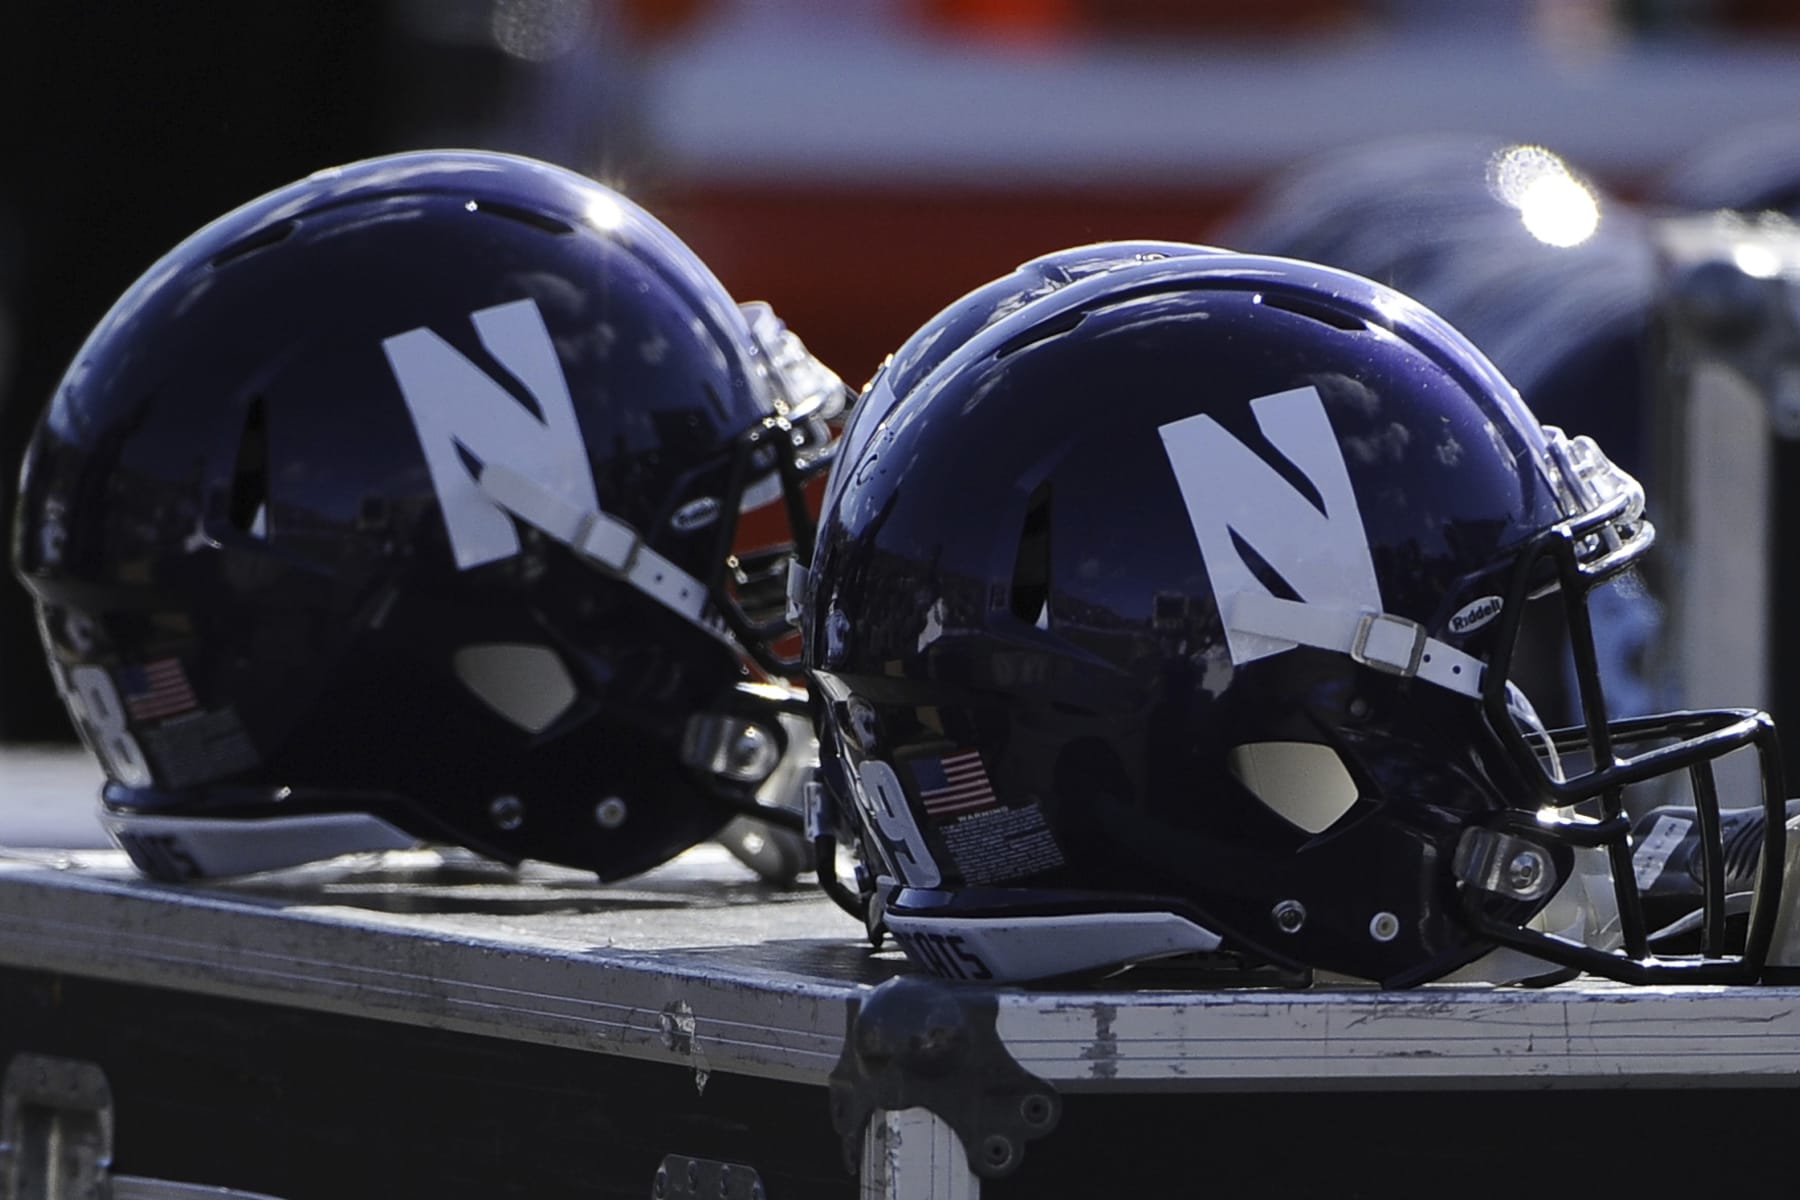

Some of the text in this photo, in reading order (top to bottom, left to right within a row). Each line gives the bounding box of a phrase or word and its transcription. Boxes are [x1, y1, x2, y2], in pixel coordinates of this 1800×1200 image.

[381, 297, 600, 570] N
[1158, 385, 1384, 666] N
[1451, 598, 1501, 631] Riddell
